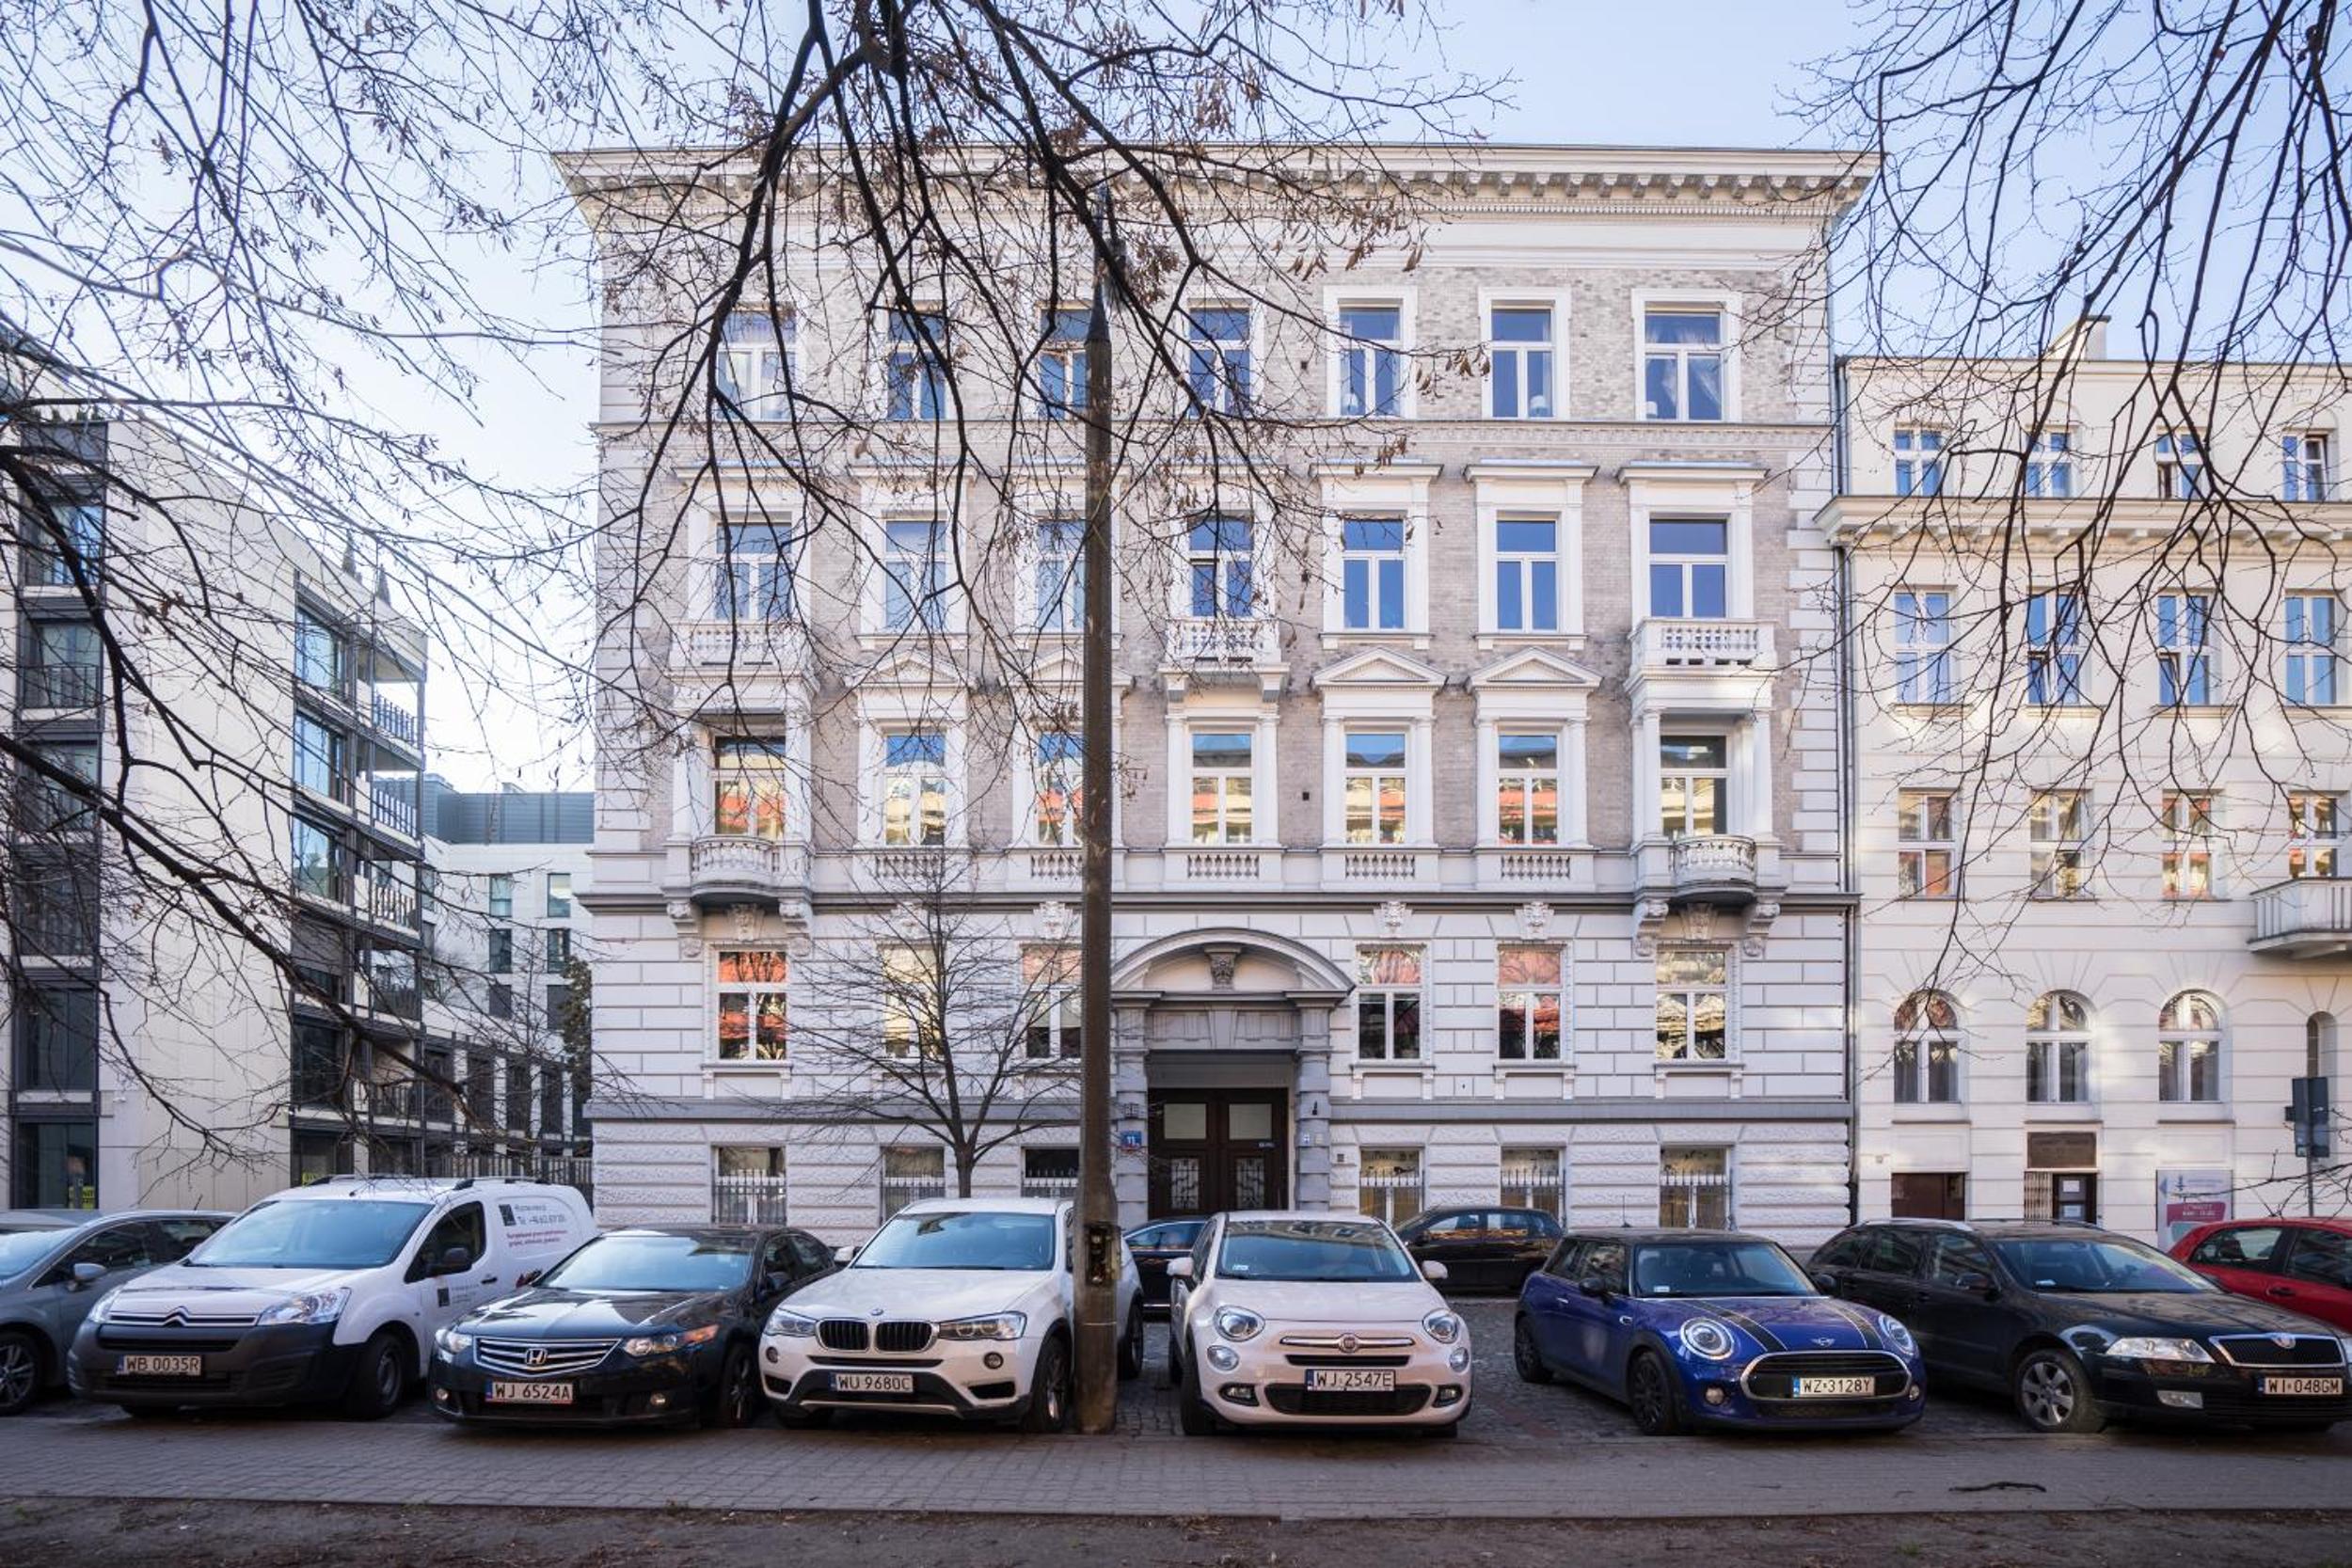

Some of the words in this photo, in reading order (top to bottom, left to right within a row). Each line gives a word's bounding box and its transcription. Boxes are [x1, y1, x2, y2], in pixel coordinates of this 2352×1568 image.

[126, 1357, 148, 1371] WB
[152, 1357, 199, 1371] 0035R
[838, 1375, 860, 1389] WU
[865, 1375, 911, 1390] 9680C
[1317, 1372, 1337, 1386] WJ
[1344, 1372, 1391, 1387] 2547E
[1803, 1379, 1822, 1393] WZ
[1827, 1379, 1870, 1393] 3128Y
[2268, 1379, 2286, 1393] WI
[2294, 1379, 2340, 1393] 048GM
[495, 1384, 516, 1399] WJ
[522, 1384, 570, 1401] 6524A
